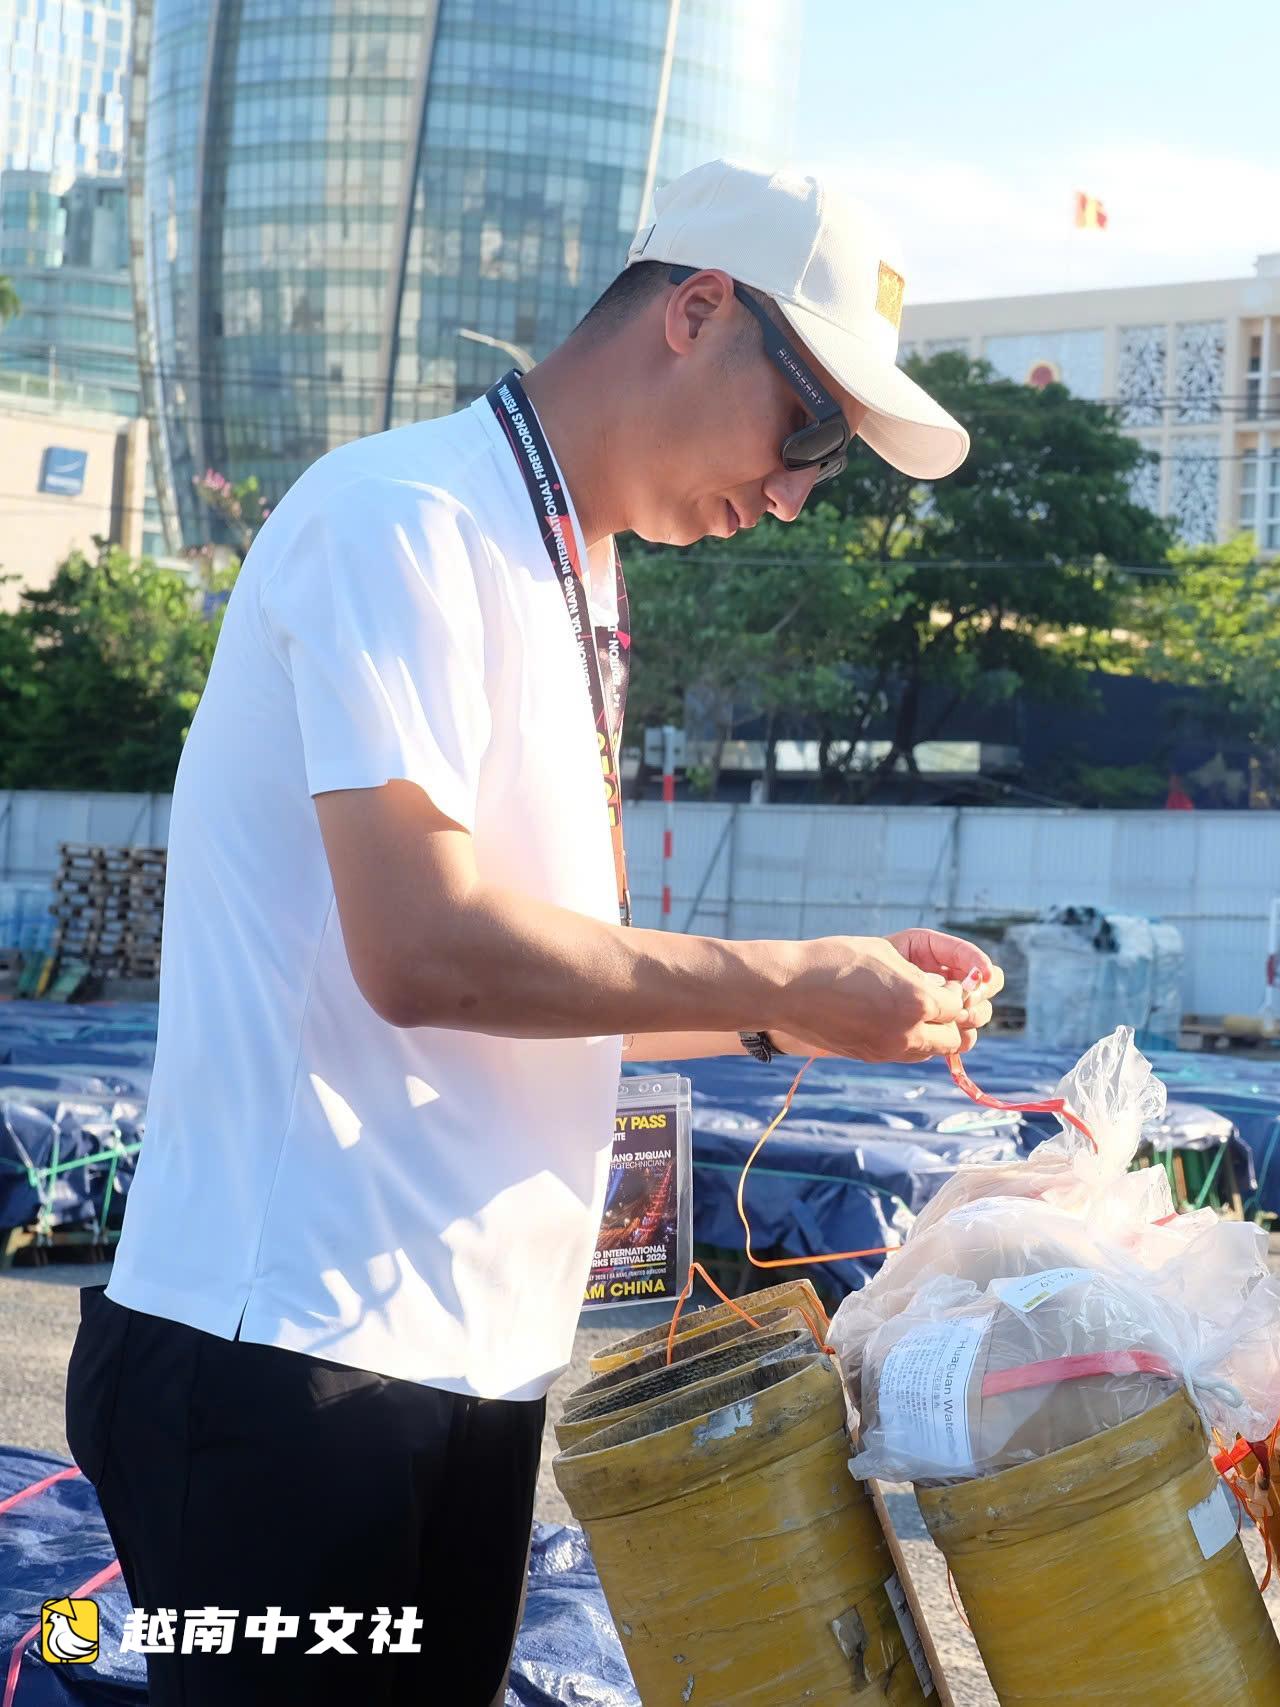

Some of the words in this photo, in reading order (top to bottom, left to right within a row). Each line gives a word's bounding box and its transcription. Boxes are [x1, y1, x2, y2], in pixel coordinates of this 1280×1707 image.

[498, 384, 520, 414] FESTIVAL
[512, 413, 547, 480] FIREWORKS
[539, 480, 572, 575] INTERNATIONAL
[564, 576, 580, 614] NANG
[631, 1114, 667, 1131] PASS
[634, 1149, 672, 1161] ZUQUAN
[603, 1244, 667, 1258] INTERNATIONAL
[610, 1253, 645, 1266] FESTIVAL
[646, 1252, 667, 1263] 2026
[610, 1278, 667, 1298] CHINA
